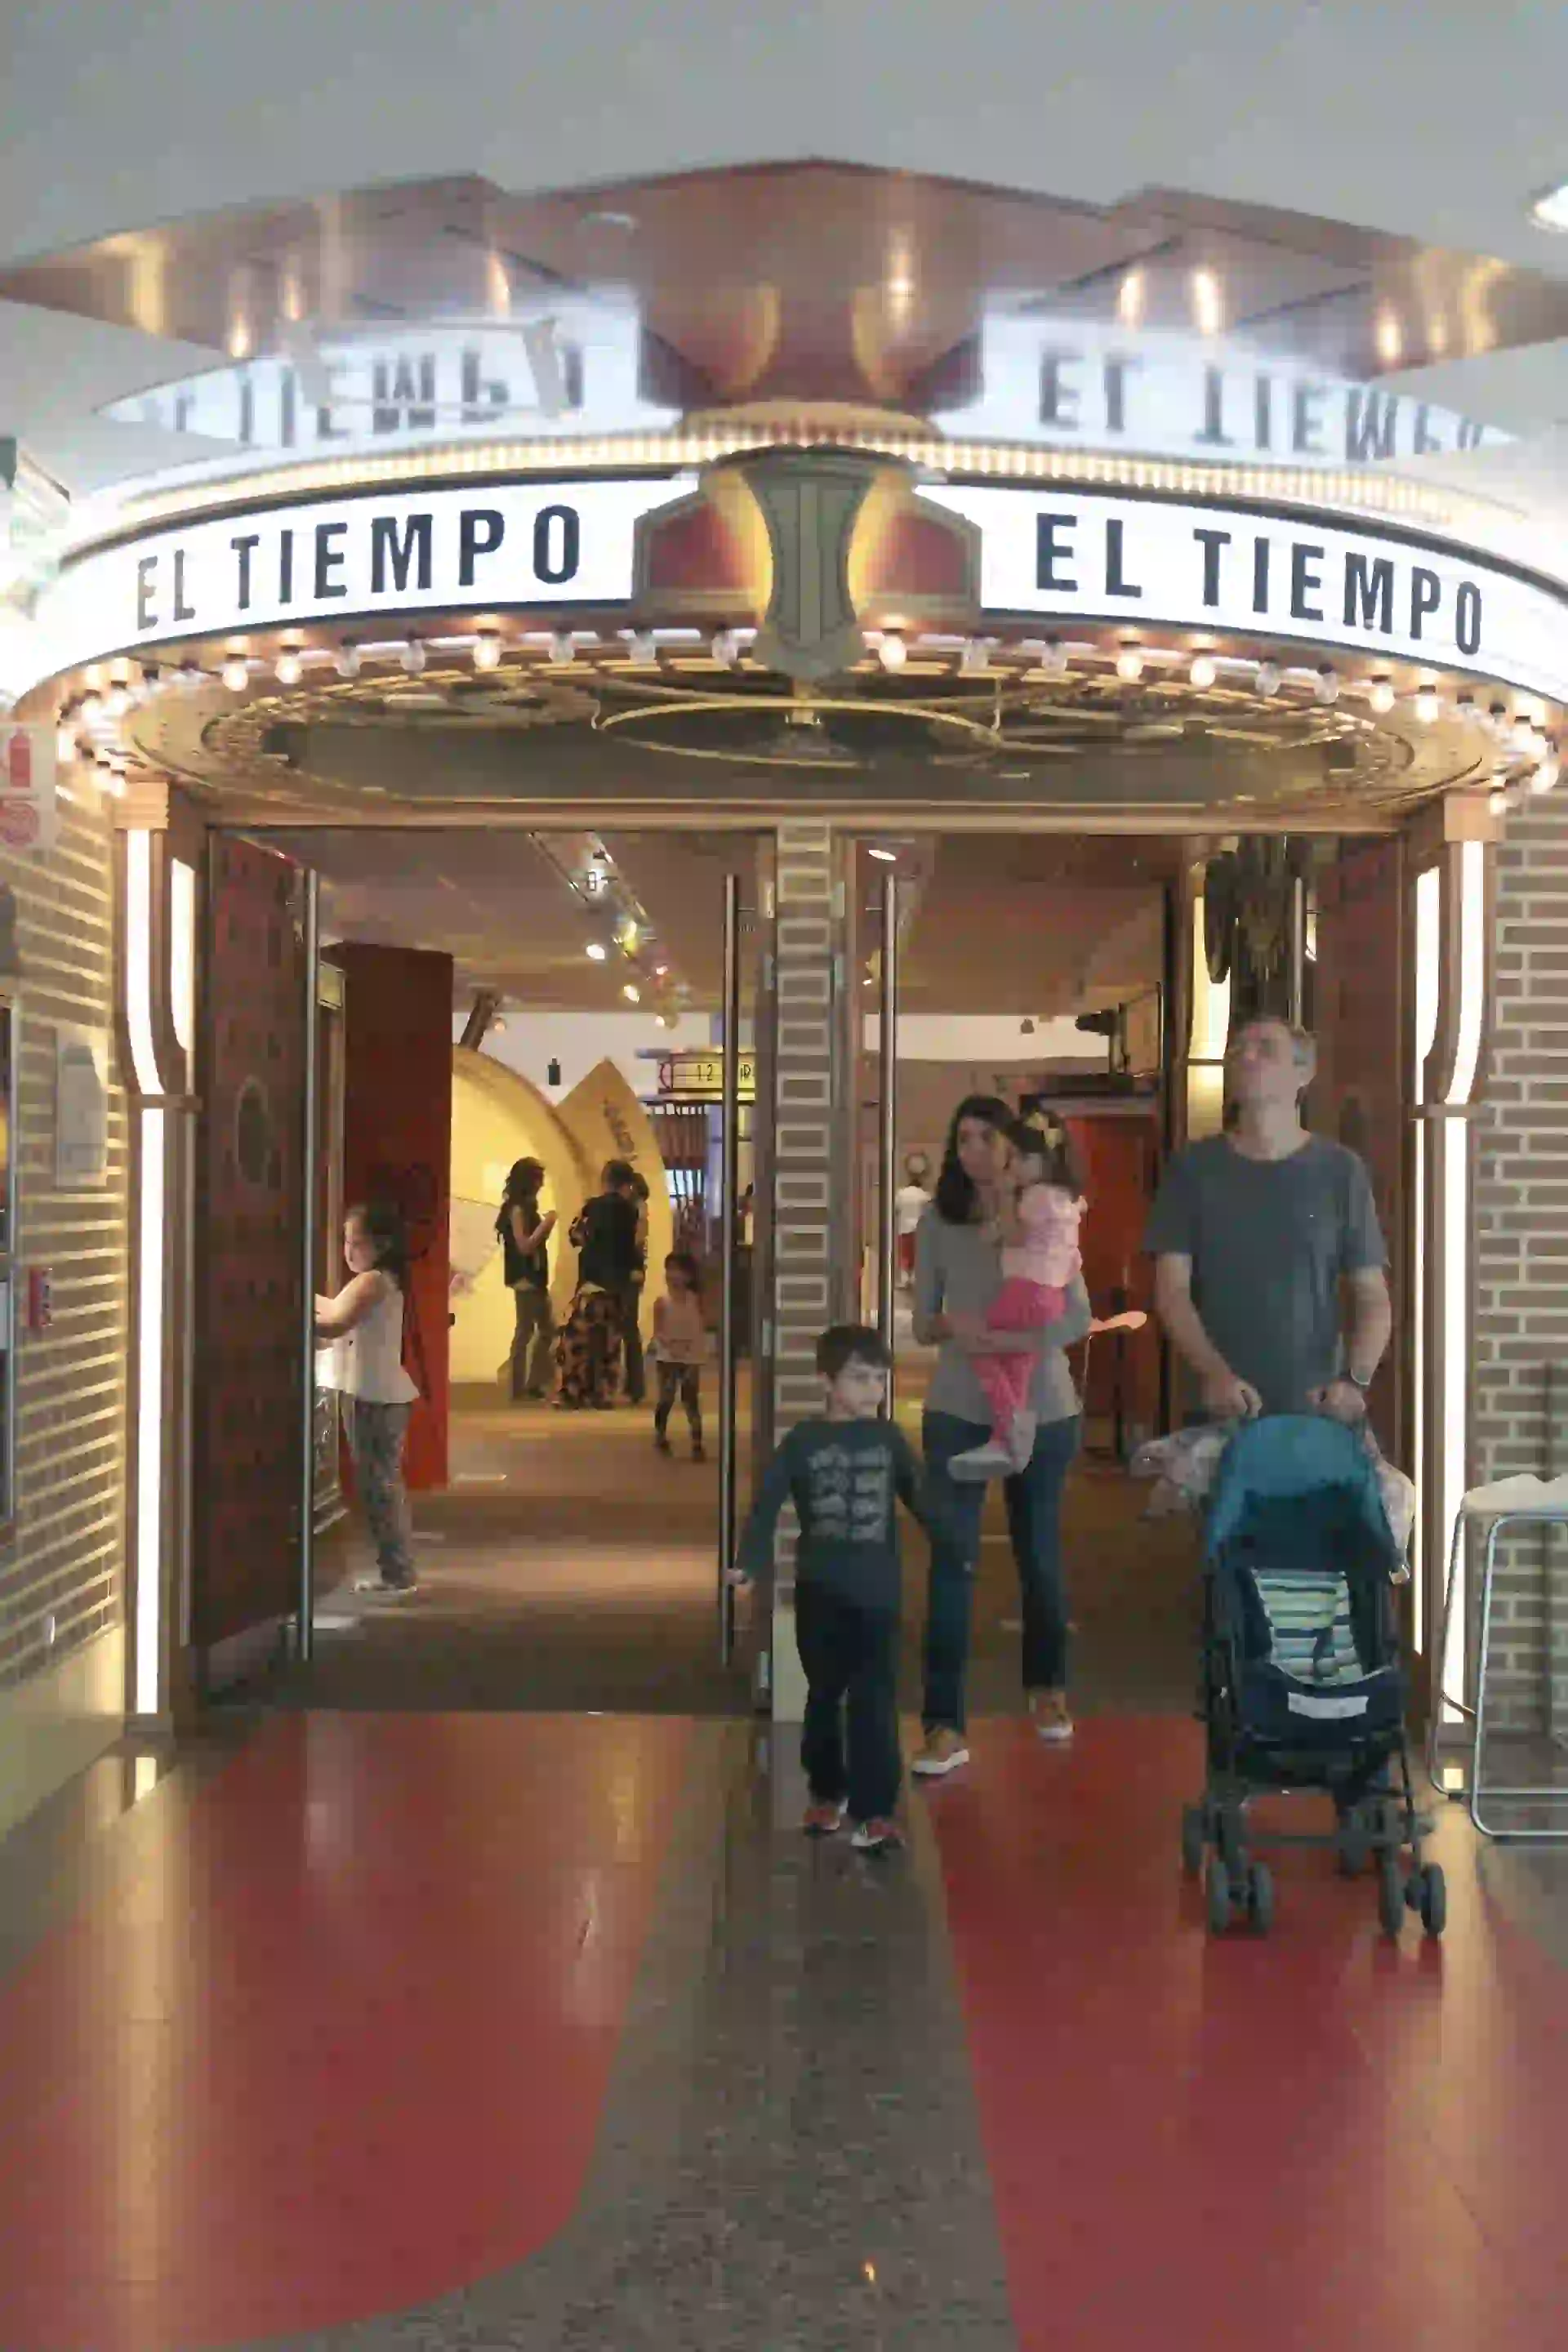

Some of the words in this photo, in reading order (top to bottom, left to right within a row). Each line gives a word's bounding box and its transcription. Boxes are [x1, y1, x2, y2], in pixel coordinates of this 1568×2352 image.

[137, 549, 196, 630] EL
[231, 505, 580, 610] TIEMPO
[1036, 513, 1142, 598] EL
[1193, 529, 1482, 656] TIEMPO
